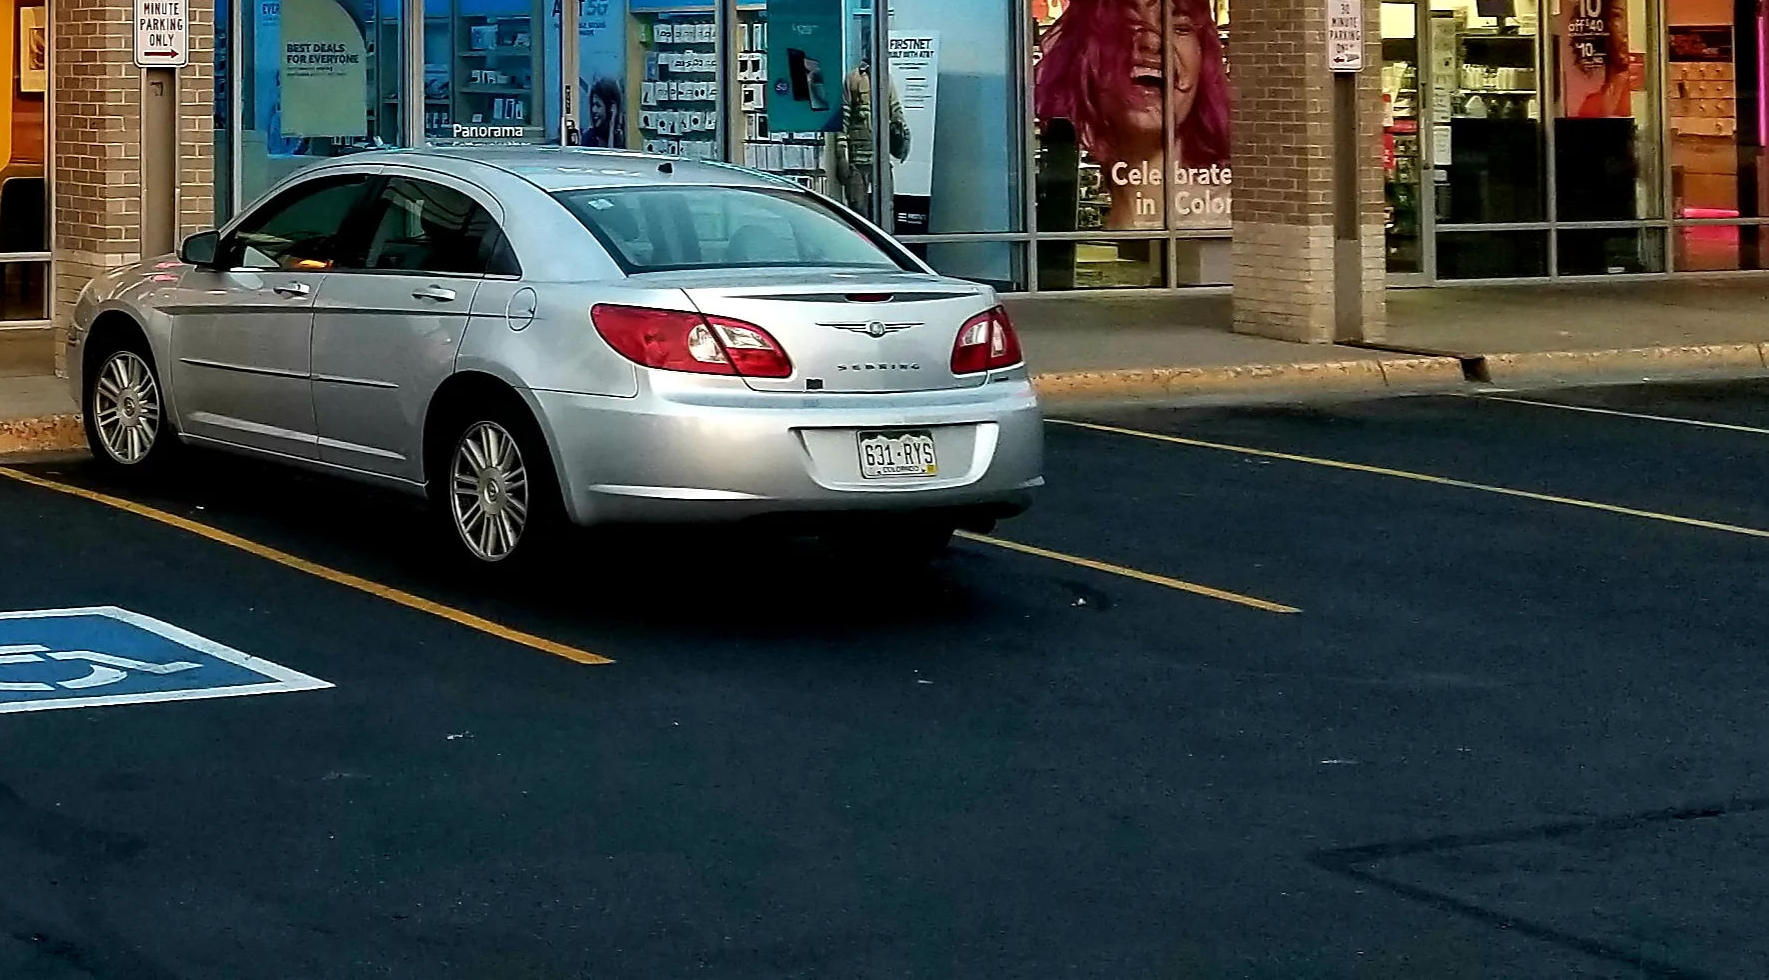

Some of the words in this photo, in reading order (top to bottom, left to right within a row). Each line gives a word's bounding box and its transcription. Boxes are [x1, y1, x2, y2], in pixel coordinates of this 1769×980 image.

[143, 2, 179, 15] MINUTE
[139, 18, 183, 31] PARKING
[149, 33, 174, 47] ONLY
[1329, 30, 1361, 41] PARKING
[286, 43, 312, 53] BEST
[313, 43, 346, 53] DEALS
[890, 38, 933, 49] FIRSTNET
[286, 54, 308, 64] FOR
[308, 54, 359, 64] EVERYONE
[452, 124, 524, 138] Panorama
[1135, 191, 1156, 215] in
